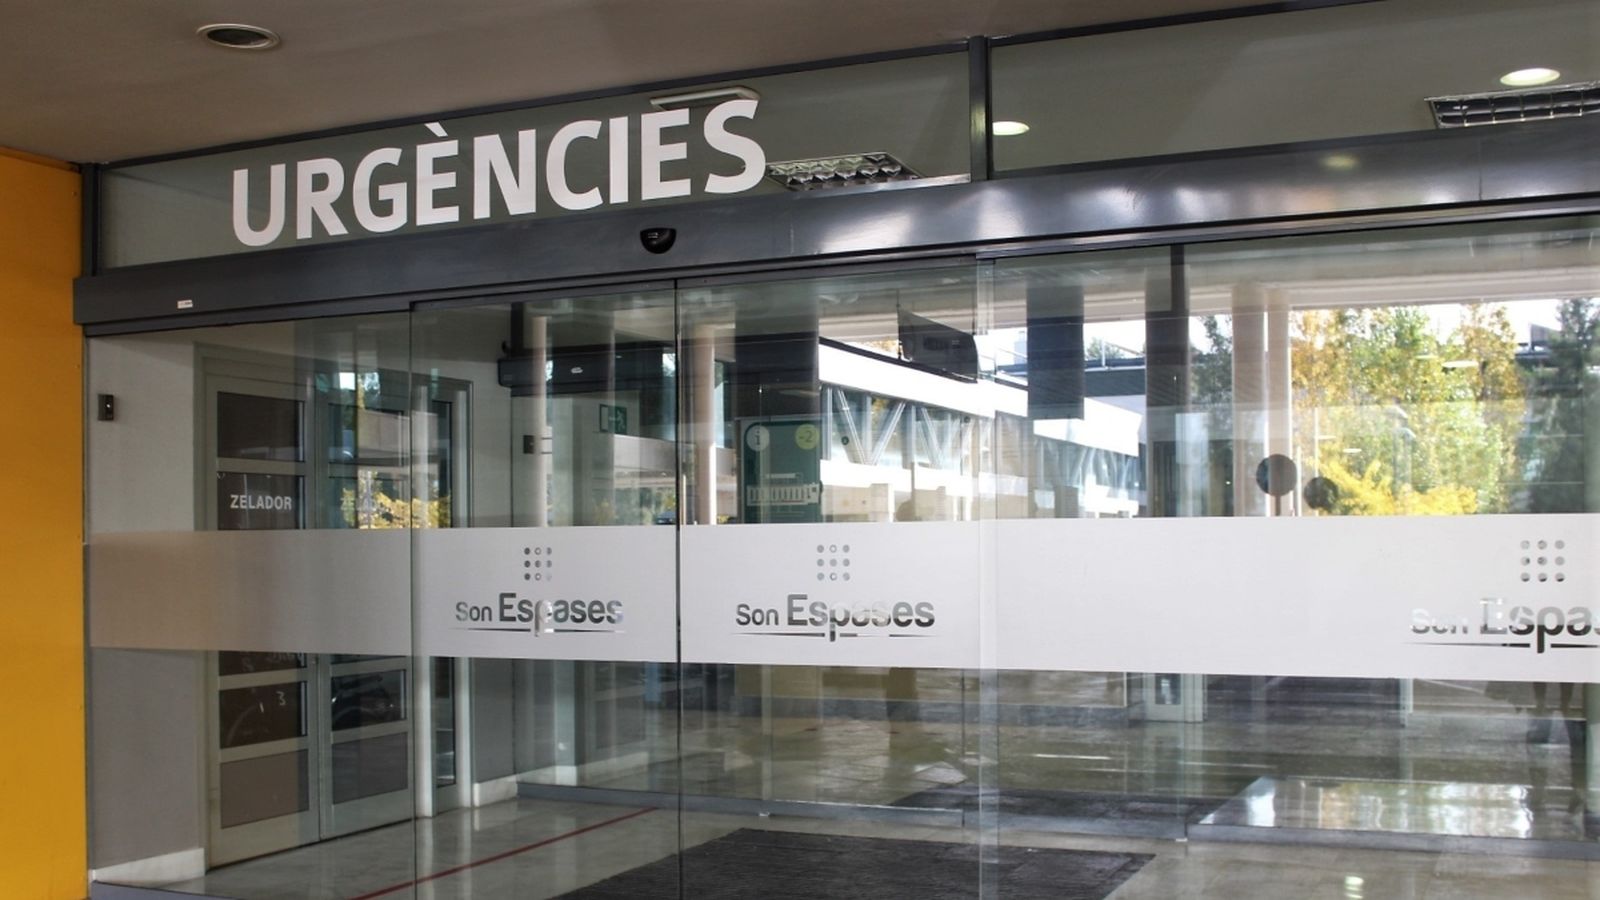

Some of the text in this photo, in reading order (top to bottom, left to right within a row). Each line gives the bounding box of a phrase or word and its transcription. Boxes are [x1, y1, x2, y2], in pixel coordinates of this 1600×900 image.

[233, 99, 767, 247] URGÈNCIES
[230, 494, 292, 510] ZELADOR
[455, 592, 624, 637] Son Espases
[736, 594, 935, 642] Son Espases
[1480, 598, 1600, 654] Espa
